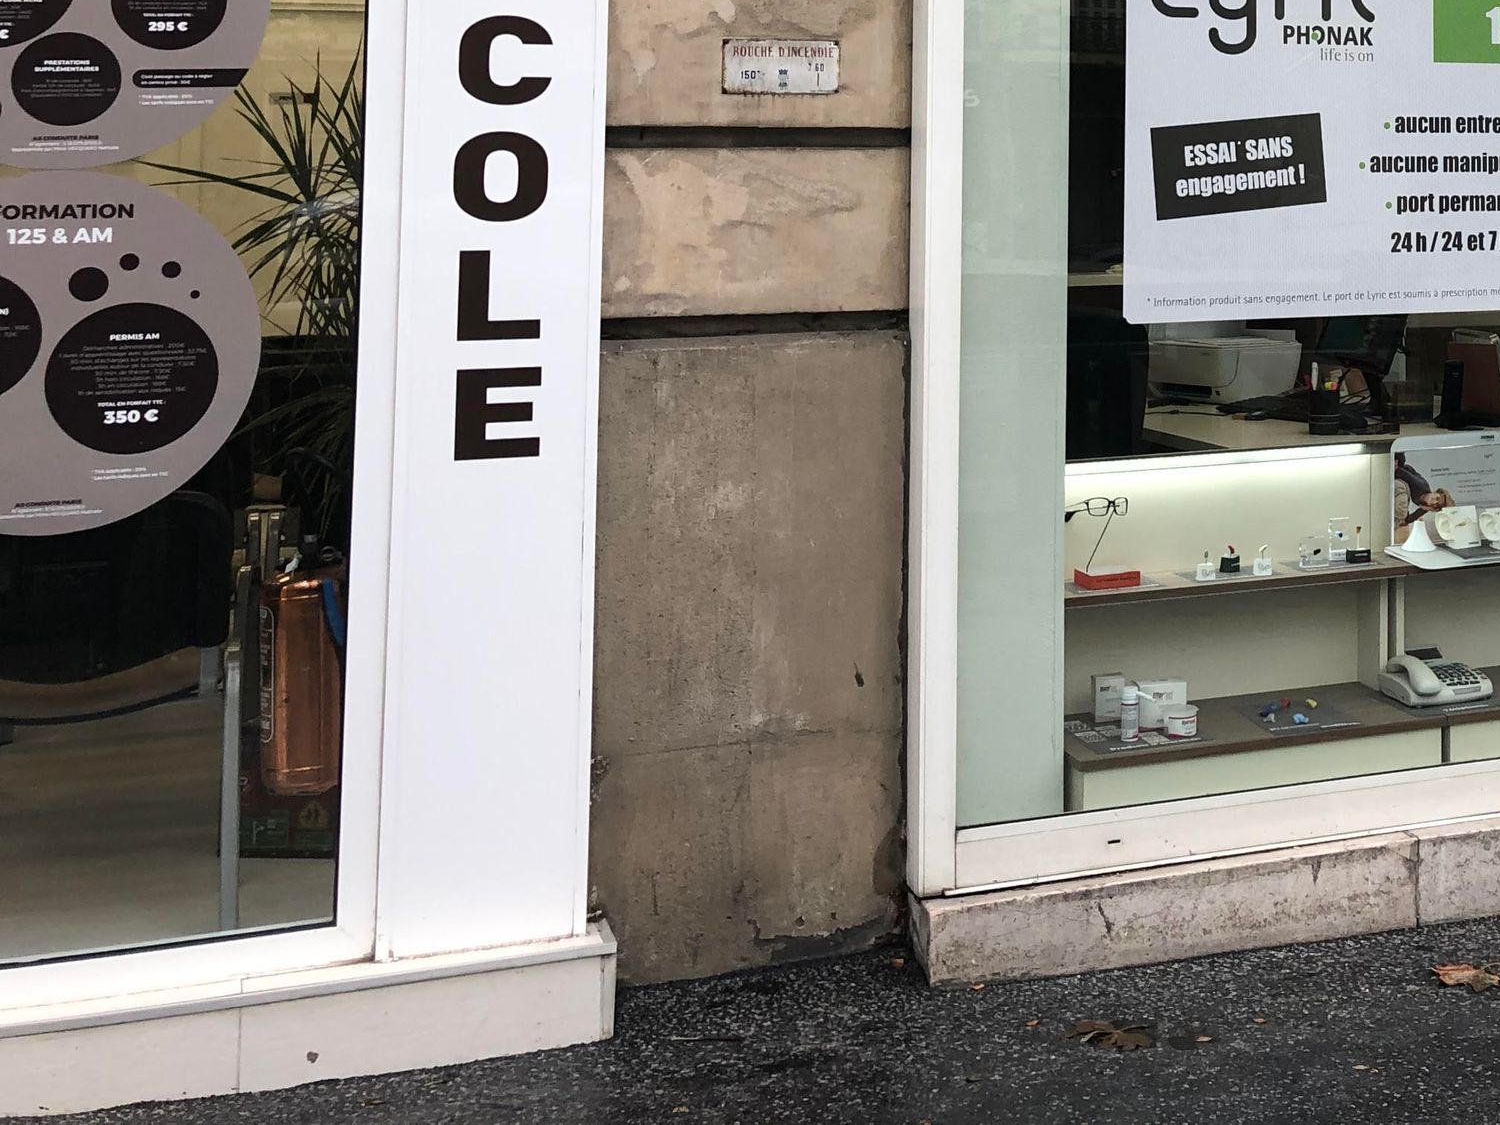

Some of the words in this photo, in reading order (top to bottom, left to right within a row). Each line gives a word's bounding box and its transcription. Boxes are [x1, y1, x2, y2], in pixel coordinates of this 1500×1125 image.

[148, 21, 174, 32] 295
[1283, 25, 1374, 46] PHONAK
[1319, 47, 1342, 62] life
[1344, 48, 1355, 62] is
[1357, 51, 1374, 62] on
[1394, 115, 1451, 134] aucun
[1244, 135, 1294, 161] SANS
[1369, 154, 1439, 173] aucune
[1175, 166, 1296, 198] engagement
[1396, 193, 1435, 215] port
[6, 228, 46, 245] 125
[52, 228, 68, 244] &
[72, 227, 113, 244] AM
[1467, 232, 1485, 252] et
[1154, 296, 1207, 307] Information
[1209, 294, 1241, 307] produit
[1244, 295, 1263, 305] sans
[1265, 292, 1320, 306] engagement.
[1323, 291, 1332, 301] Le
[1334, 291, 1352, 303] port
[1354, 290, 1365, 300] de
[1367, 290, 1386, 302] Lyric
[1388, 290, 1401, 300] est
[1403, 288, 1432, 299] soumis
[1441, 287, 1488, 299] prescription
[109, 333, 144, 342] PERMIS
[145, 332, 160, 341] AM
[103, 410, 141, 424] 350
[144, 408, 159, 422] €
